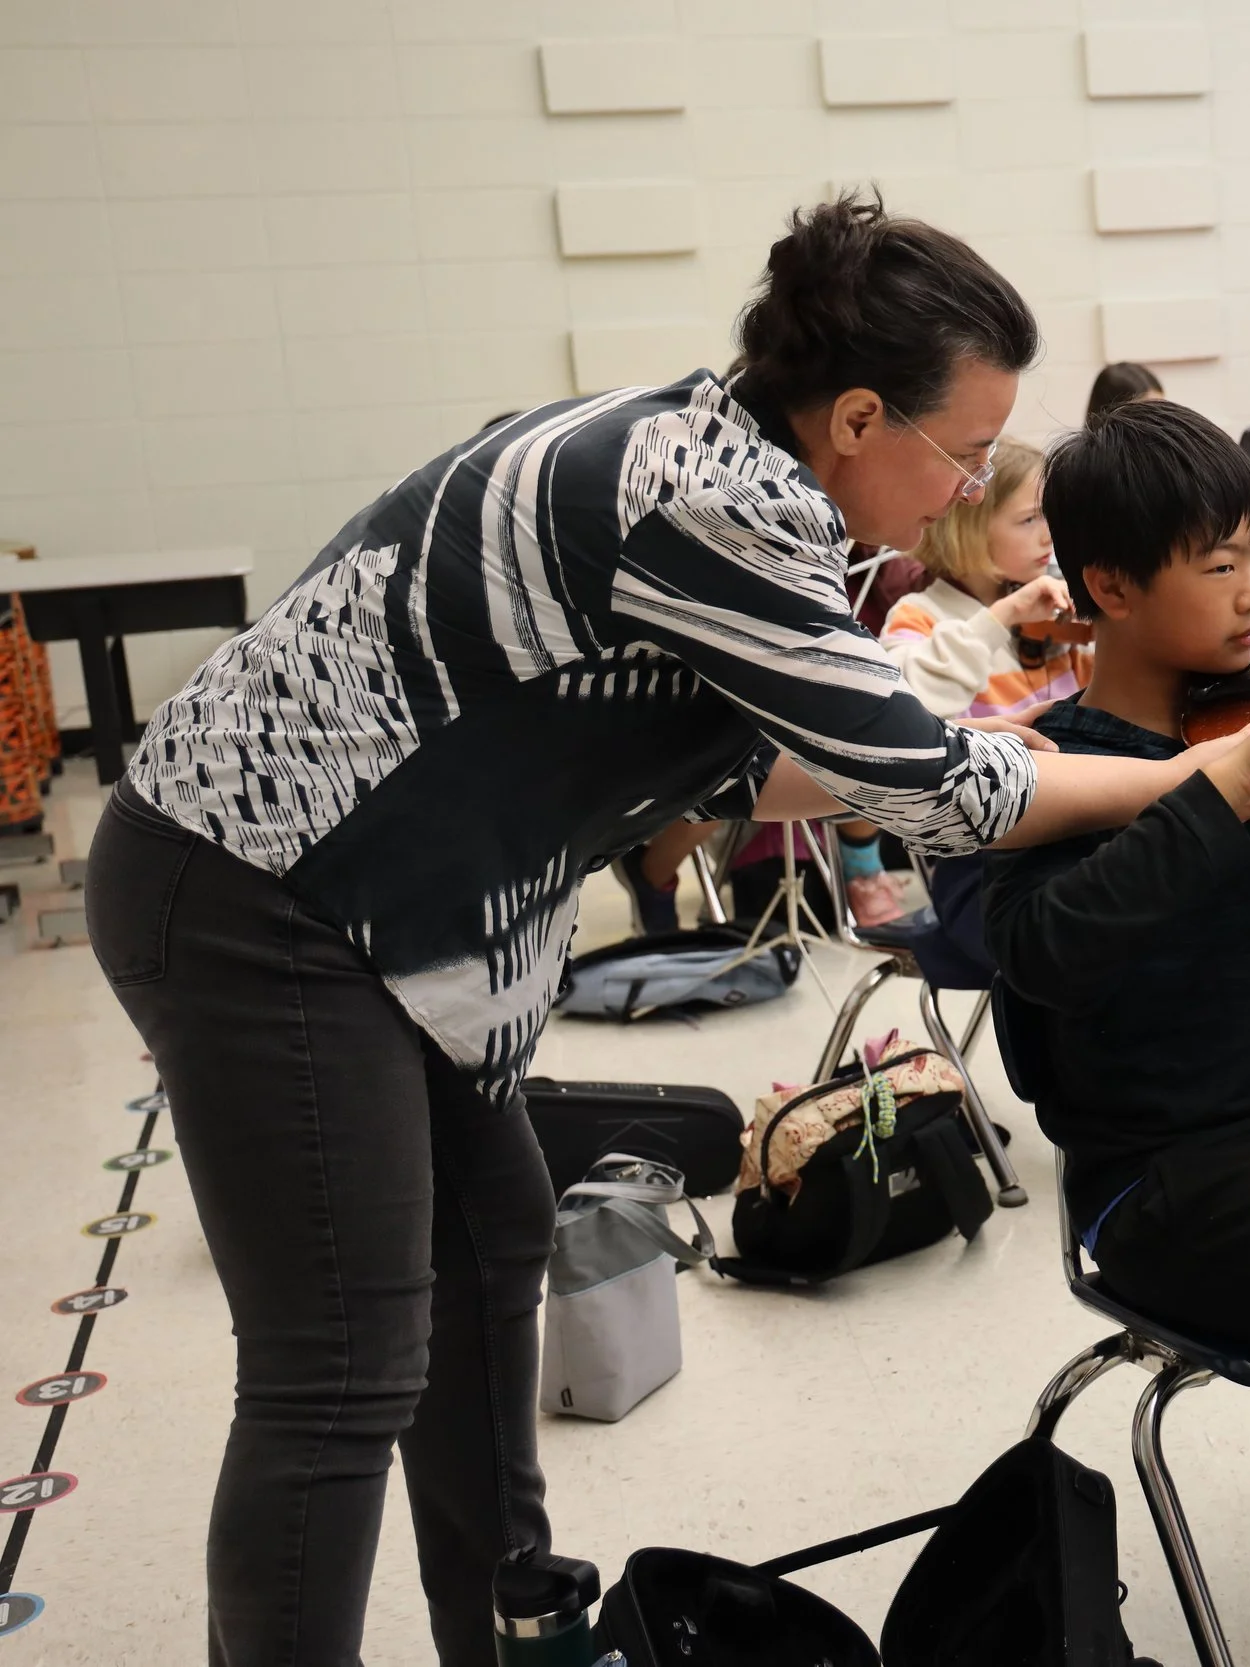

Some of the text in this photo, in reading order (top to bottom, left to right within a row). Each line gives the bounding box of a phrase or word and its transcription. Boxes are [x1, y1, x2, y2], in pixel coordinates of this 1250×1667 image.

[97, 1215, 140, 1234] 15
[38, 1376, 86, 1399] 13
[1, 1477, 54, 1505] 12
